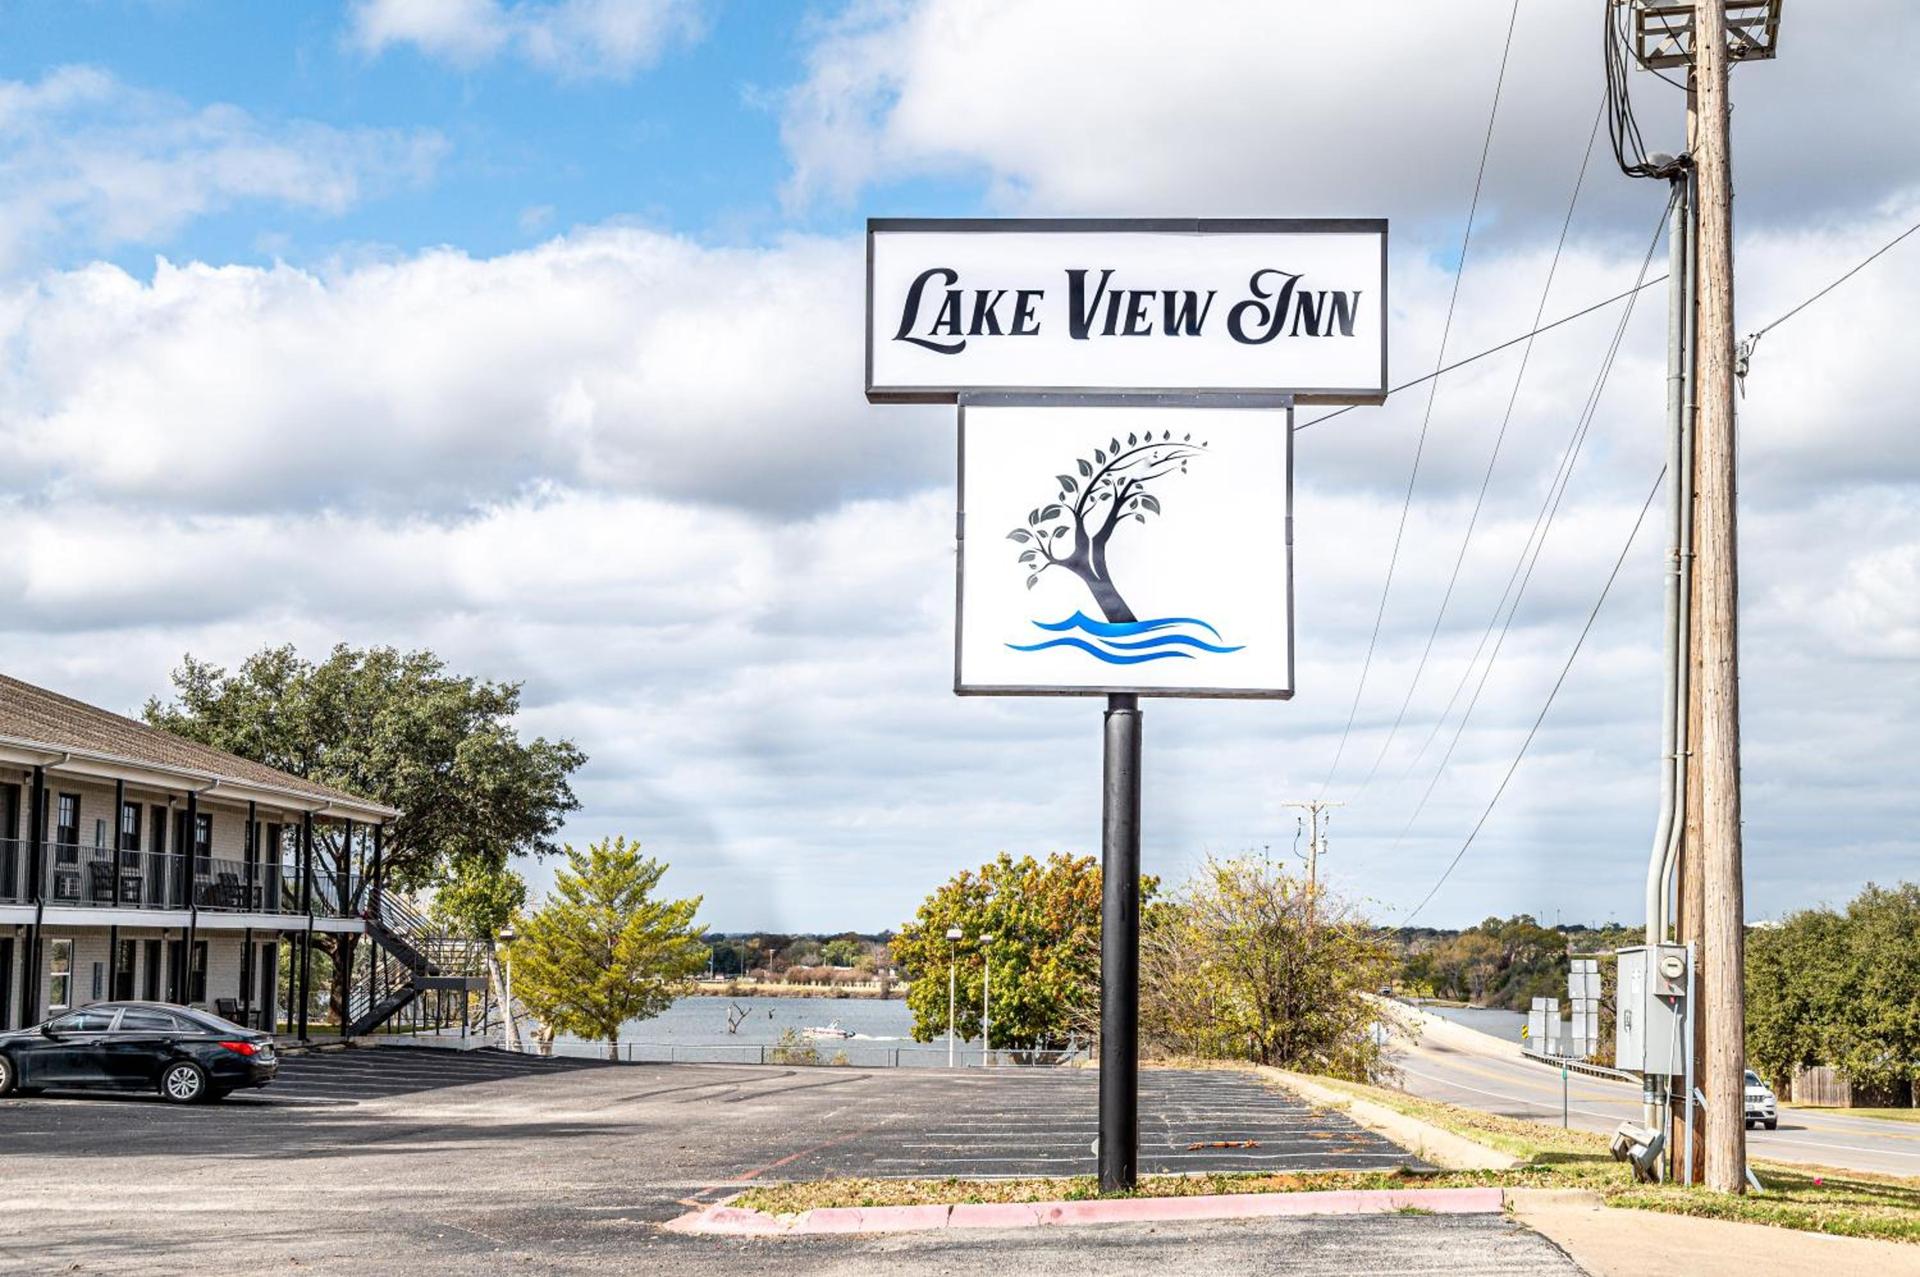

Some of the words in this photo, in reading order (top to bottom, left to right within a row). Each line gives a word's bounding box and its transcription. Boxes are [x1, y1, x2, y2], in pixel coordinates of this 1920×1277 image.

[892, 268, 1045, 355] LAKE
[1065, 269, 1218, 340] VIEW
[1227, 269, 1362, 345] INN
